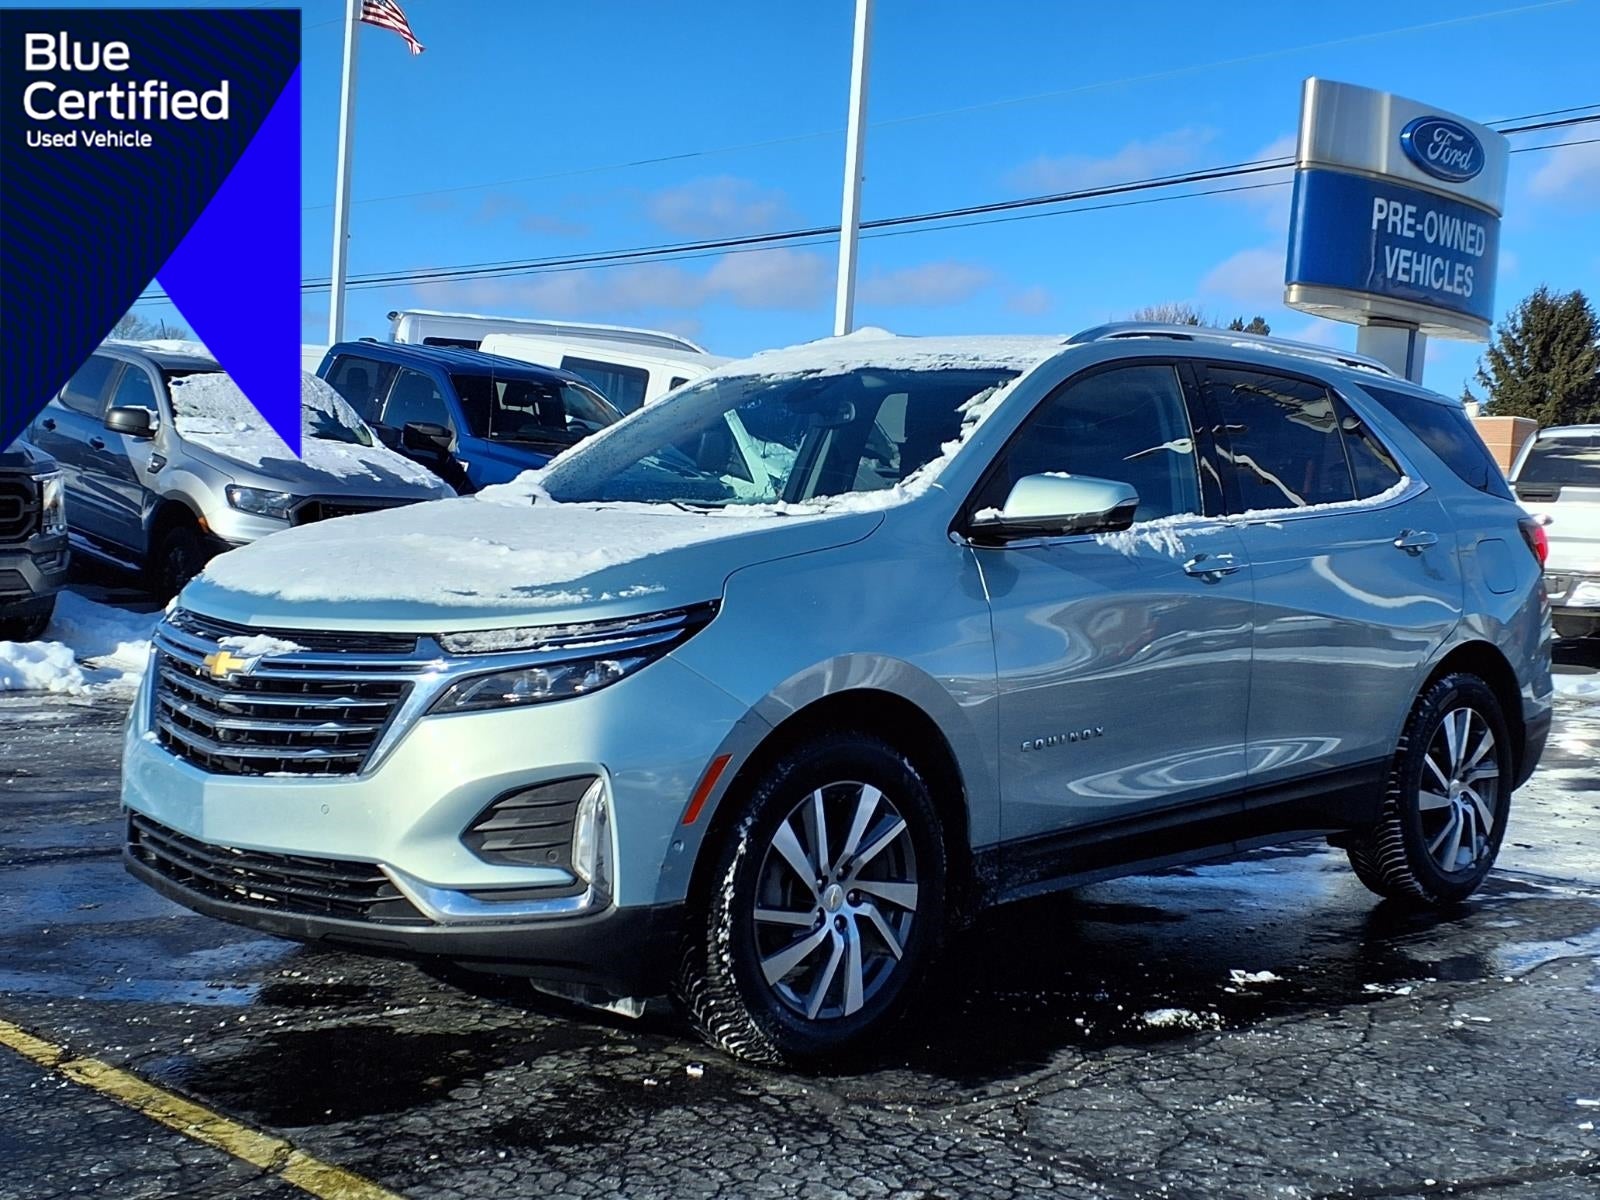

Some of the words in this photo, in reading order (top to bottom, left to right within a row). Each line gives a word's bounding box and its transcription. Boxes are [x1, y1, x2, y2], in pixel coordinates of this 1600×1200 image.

[1427, 127, 1474, 170] Ford
[1372, 197, 1486, 257] PRE-OWNED
[1385, 245, 1474, 298] VEHICLES
[1021, 726, 1104, 752] EQUINOX
